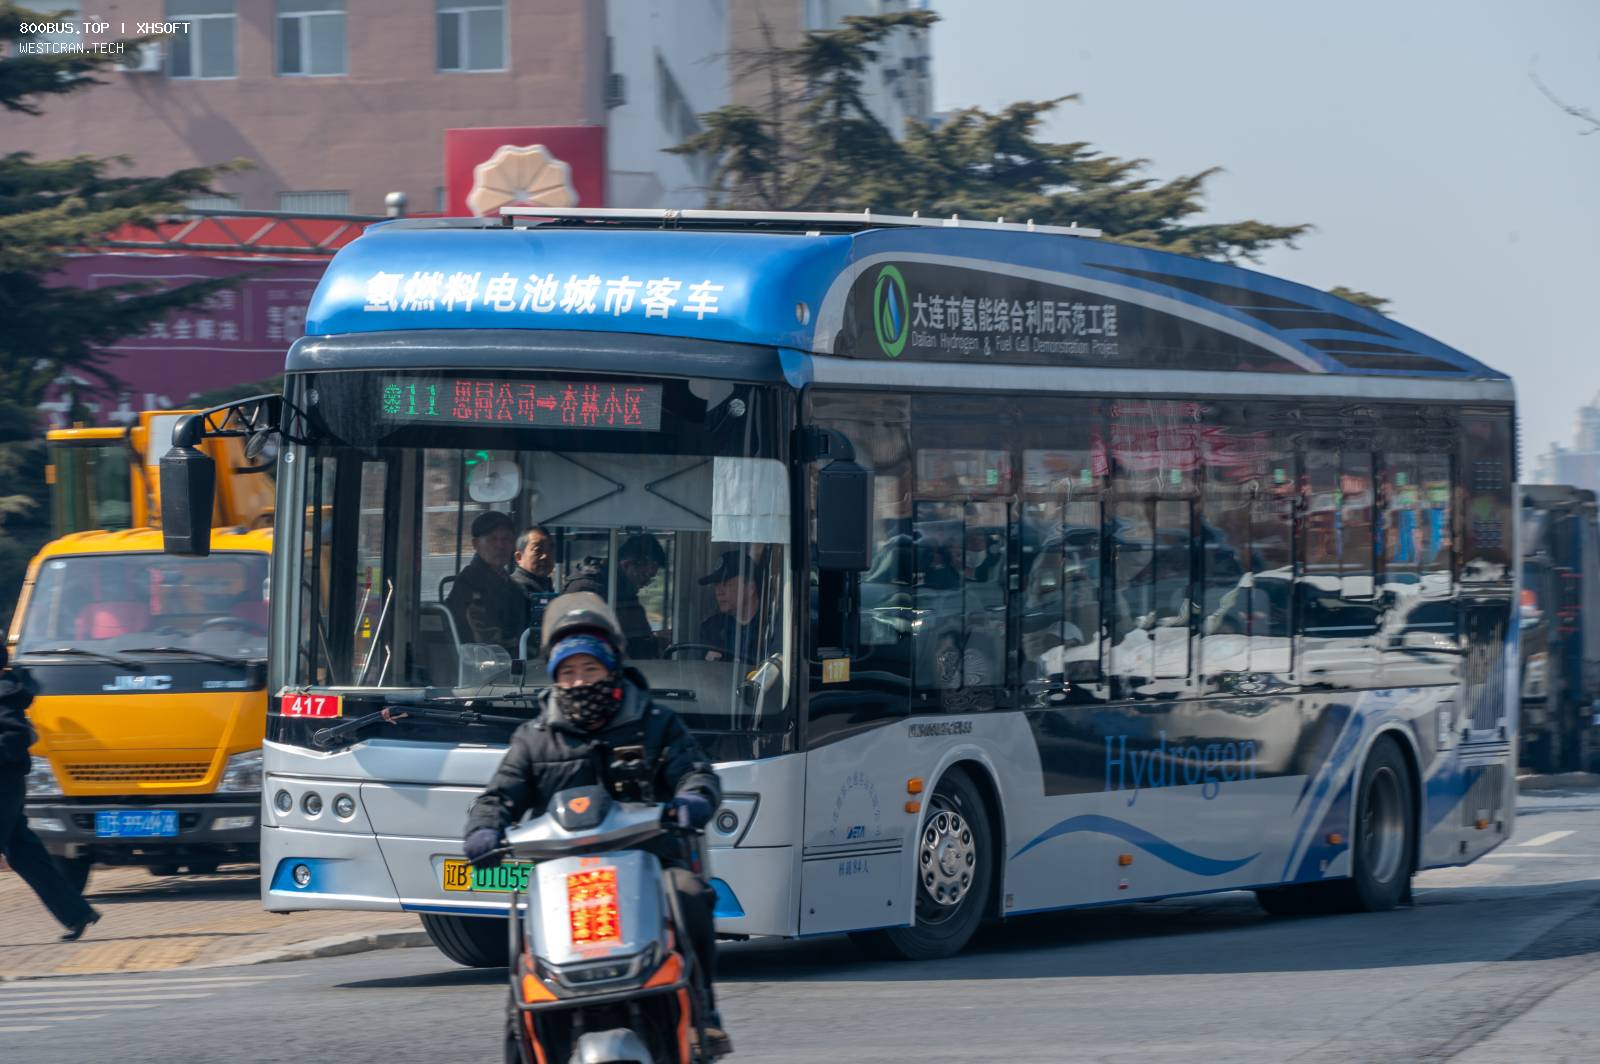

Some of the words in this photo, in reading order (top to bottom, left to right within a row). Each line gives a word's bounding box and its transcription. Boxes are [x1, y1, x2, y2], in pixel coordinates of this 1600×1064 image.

[363, 271, 724, 320] 氢燃料电池城市客车
[912, 293, 1119, 337] 大连市氢能综合利用示范工程
[940, 333, 979, 355] Hydrogen
[984, 336, 991, 356] &
[996, 336, 1011, 351] Fuel
[291, 698, 325, 715] 417
[1105, 730, 1257, 807] Hydrogen
